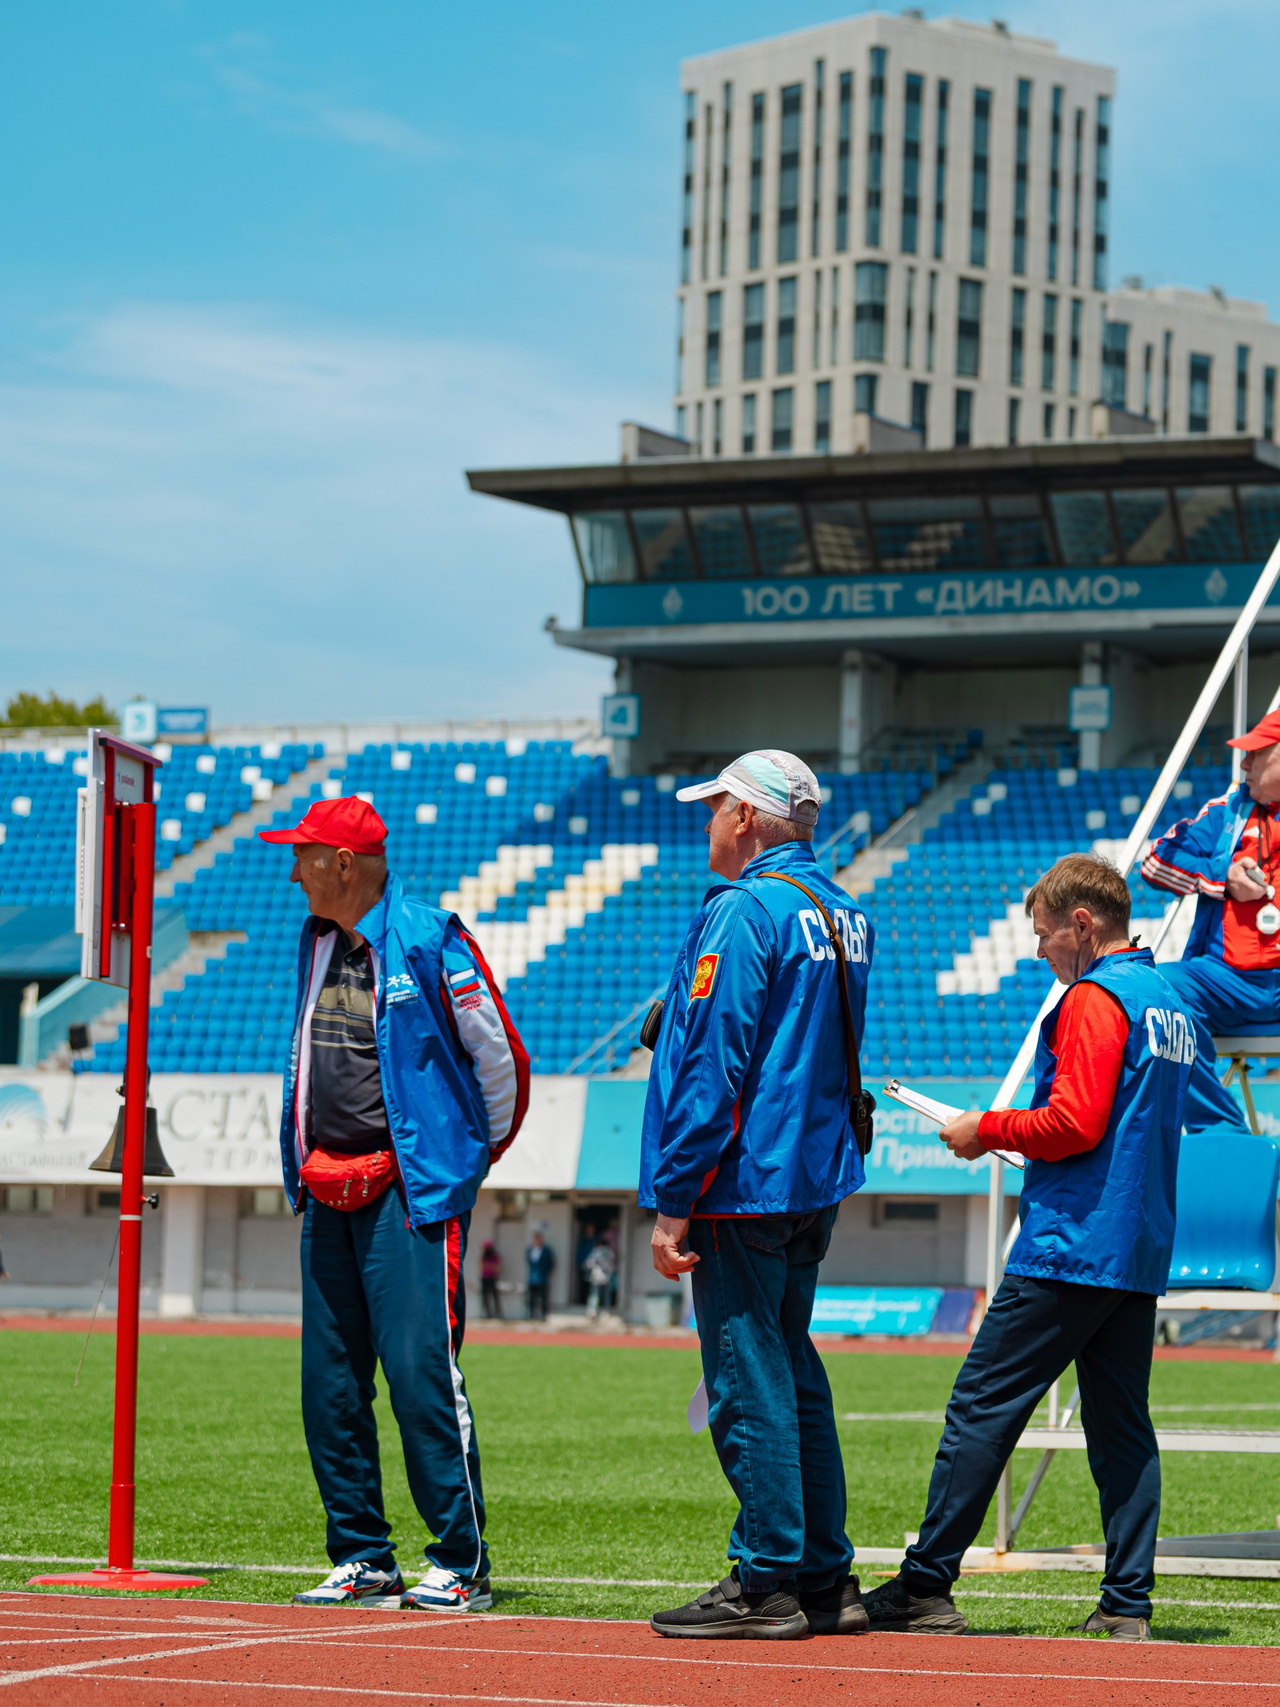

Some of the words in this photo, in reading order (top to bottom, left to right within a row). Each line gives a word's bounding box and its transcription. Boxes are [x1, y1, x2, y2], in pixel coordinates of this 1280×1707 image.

[742, 587, 809, 615] 100
[821, 583, 902, 613] ЛЕТ
[915, 575, 1142, 615] «ДИНАМО»
[1145, 1007, 1197, 1066] СУДЬ
